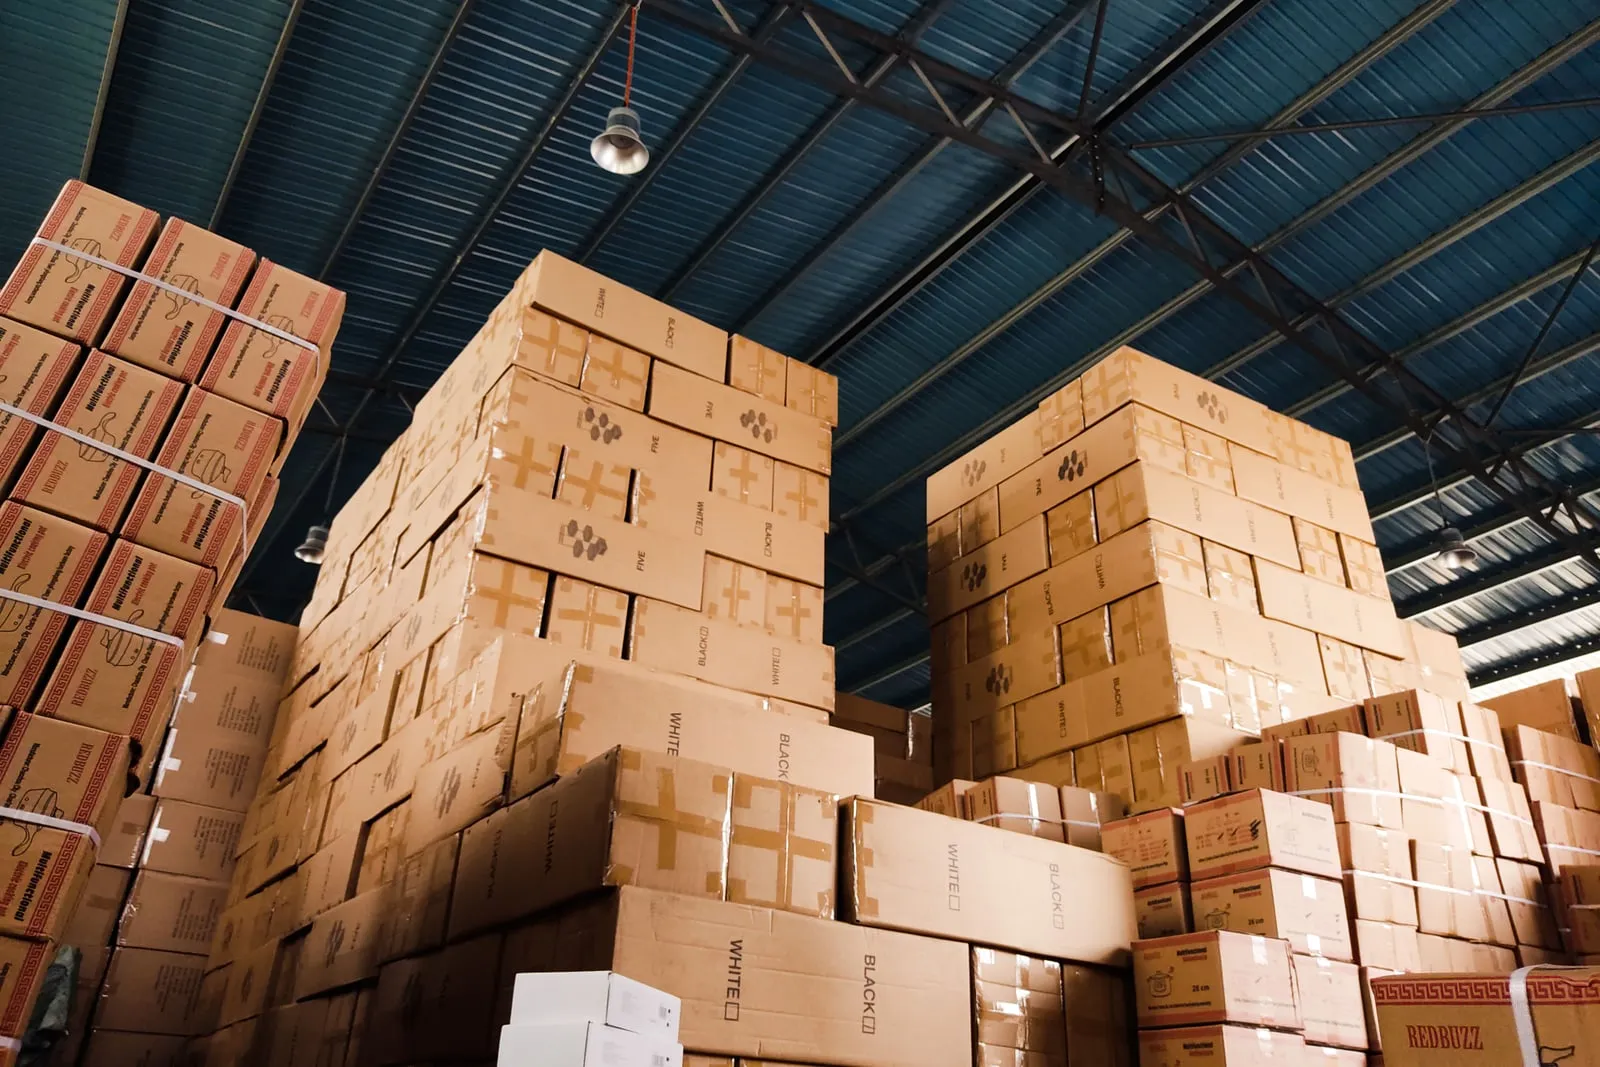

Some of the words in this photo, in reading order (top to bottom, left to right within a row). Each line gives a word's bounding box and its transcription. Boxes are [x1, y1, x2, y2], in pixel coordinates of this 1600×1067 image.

[65, 283, 95, 329] Multifunctional
[166, 320, 194, 366] Multifunctional
[84, 363, 116, 411] Multifunctional
[265, 358, 291, 403] Multifunctional
[651, 435, 660, 453] FIVE
[192, 498, 221, 550] Multifunctional
[696, 501, 704, 527] WHITE
[765, 522, 773, 548] BLACK
[0, 518, 32, 575] Multifunctional
[636, 550, 645, 571] FIVE
[111, 555, 143, 610] Multifunctional
[1096, 562, 1105, 589] WHITE
[1045, 587, 1053, 615] BLACK
[698, 636, 708, 667] BLACK
[772, 657, 780, 685] WHITE
[72, 667, 98, 708] REDBUZZ
[1113, 677, 1122, 706] BLACK
[667, 712, 682, 757] WHITE
[778, 733, 790, 779] BLACK
[65, 741, 93, 784] REDBUZZ
[13, 850, 51, 922] Multifunctional
[948, 844, 960, 893] WHITE
[1049, 863, 1062, 912] BLACK
[726, 939, 743, 999] WHITE
[863, 954, 876, 1014] BLACK
[1406, 1025, 1484, 1050] REDBUZZ
